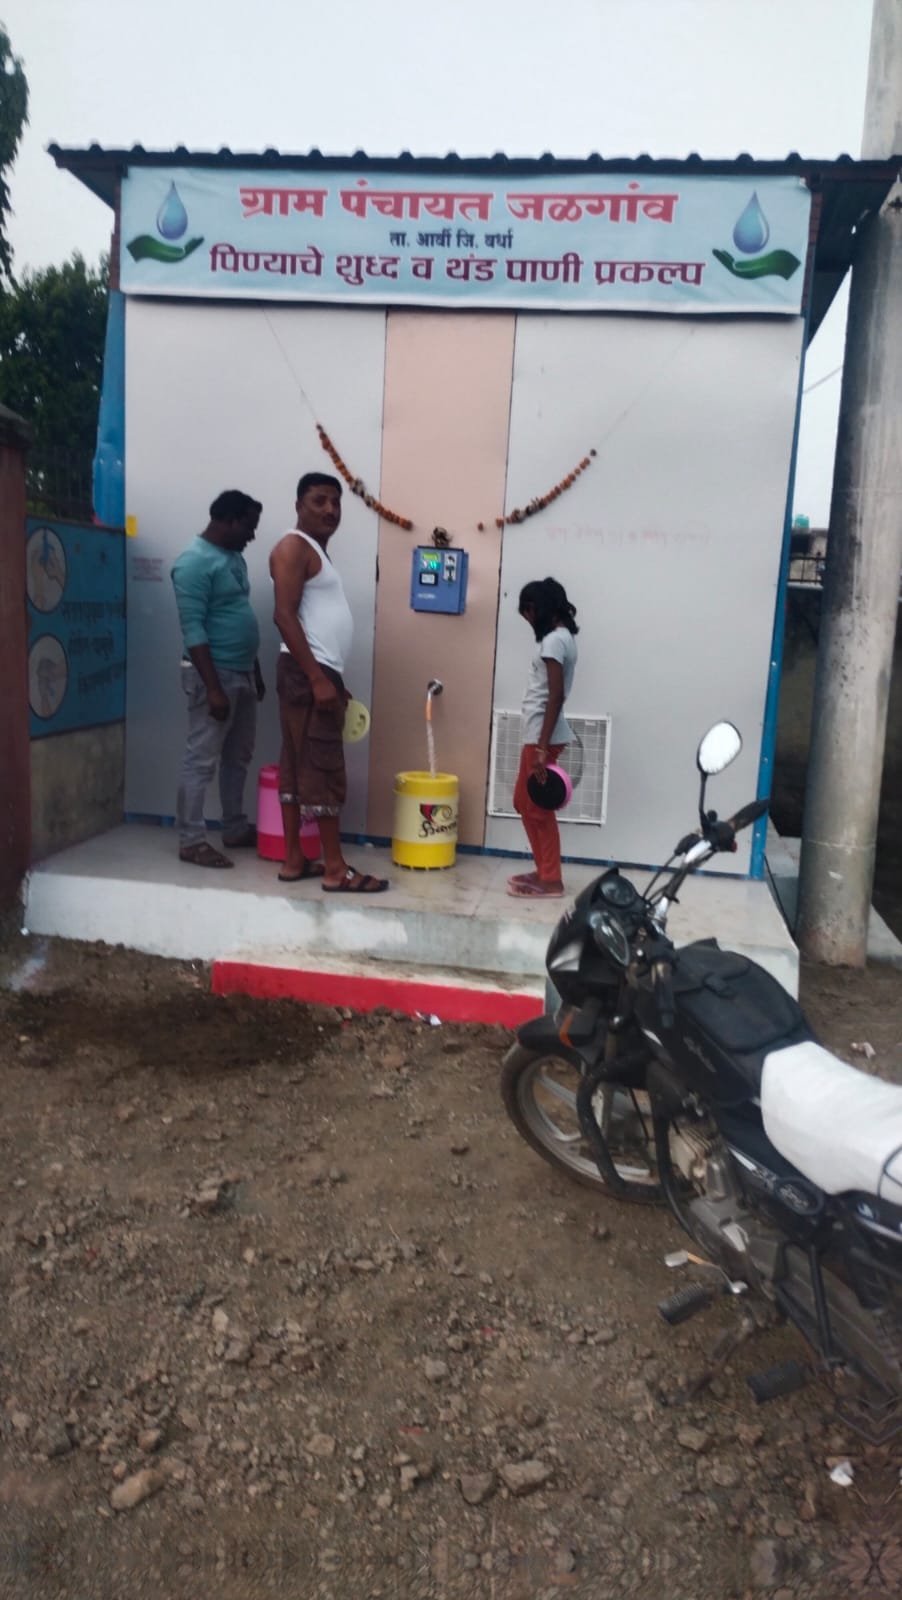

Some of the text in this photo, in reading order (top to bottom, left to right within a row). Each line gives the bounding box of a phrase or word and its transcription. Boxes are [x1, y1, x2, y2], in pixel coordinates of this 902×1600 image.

[239, 178, 678, 223] ग्राम पंचायत जळगांव
[389, 231, 410, 248] ता.
[456, 229, 479, 249] जि.
[484, 229, 514, 249] वर्धा
[210, 243, 706, 285] पिण्याचे शुध्द व थंड पाणी प्रकल्प
